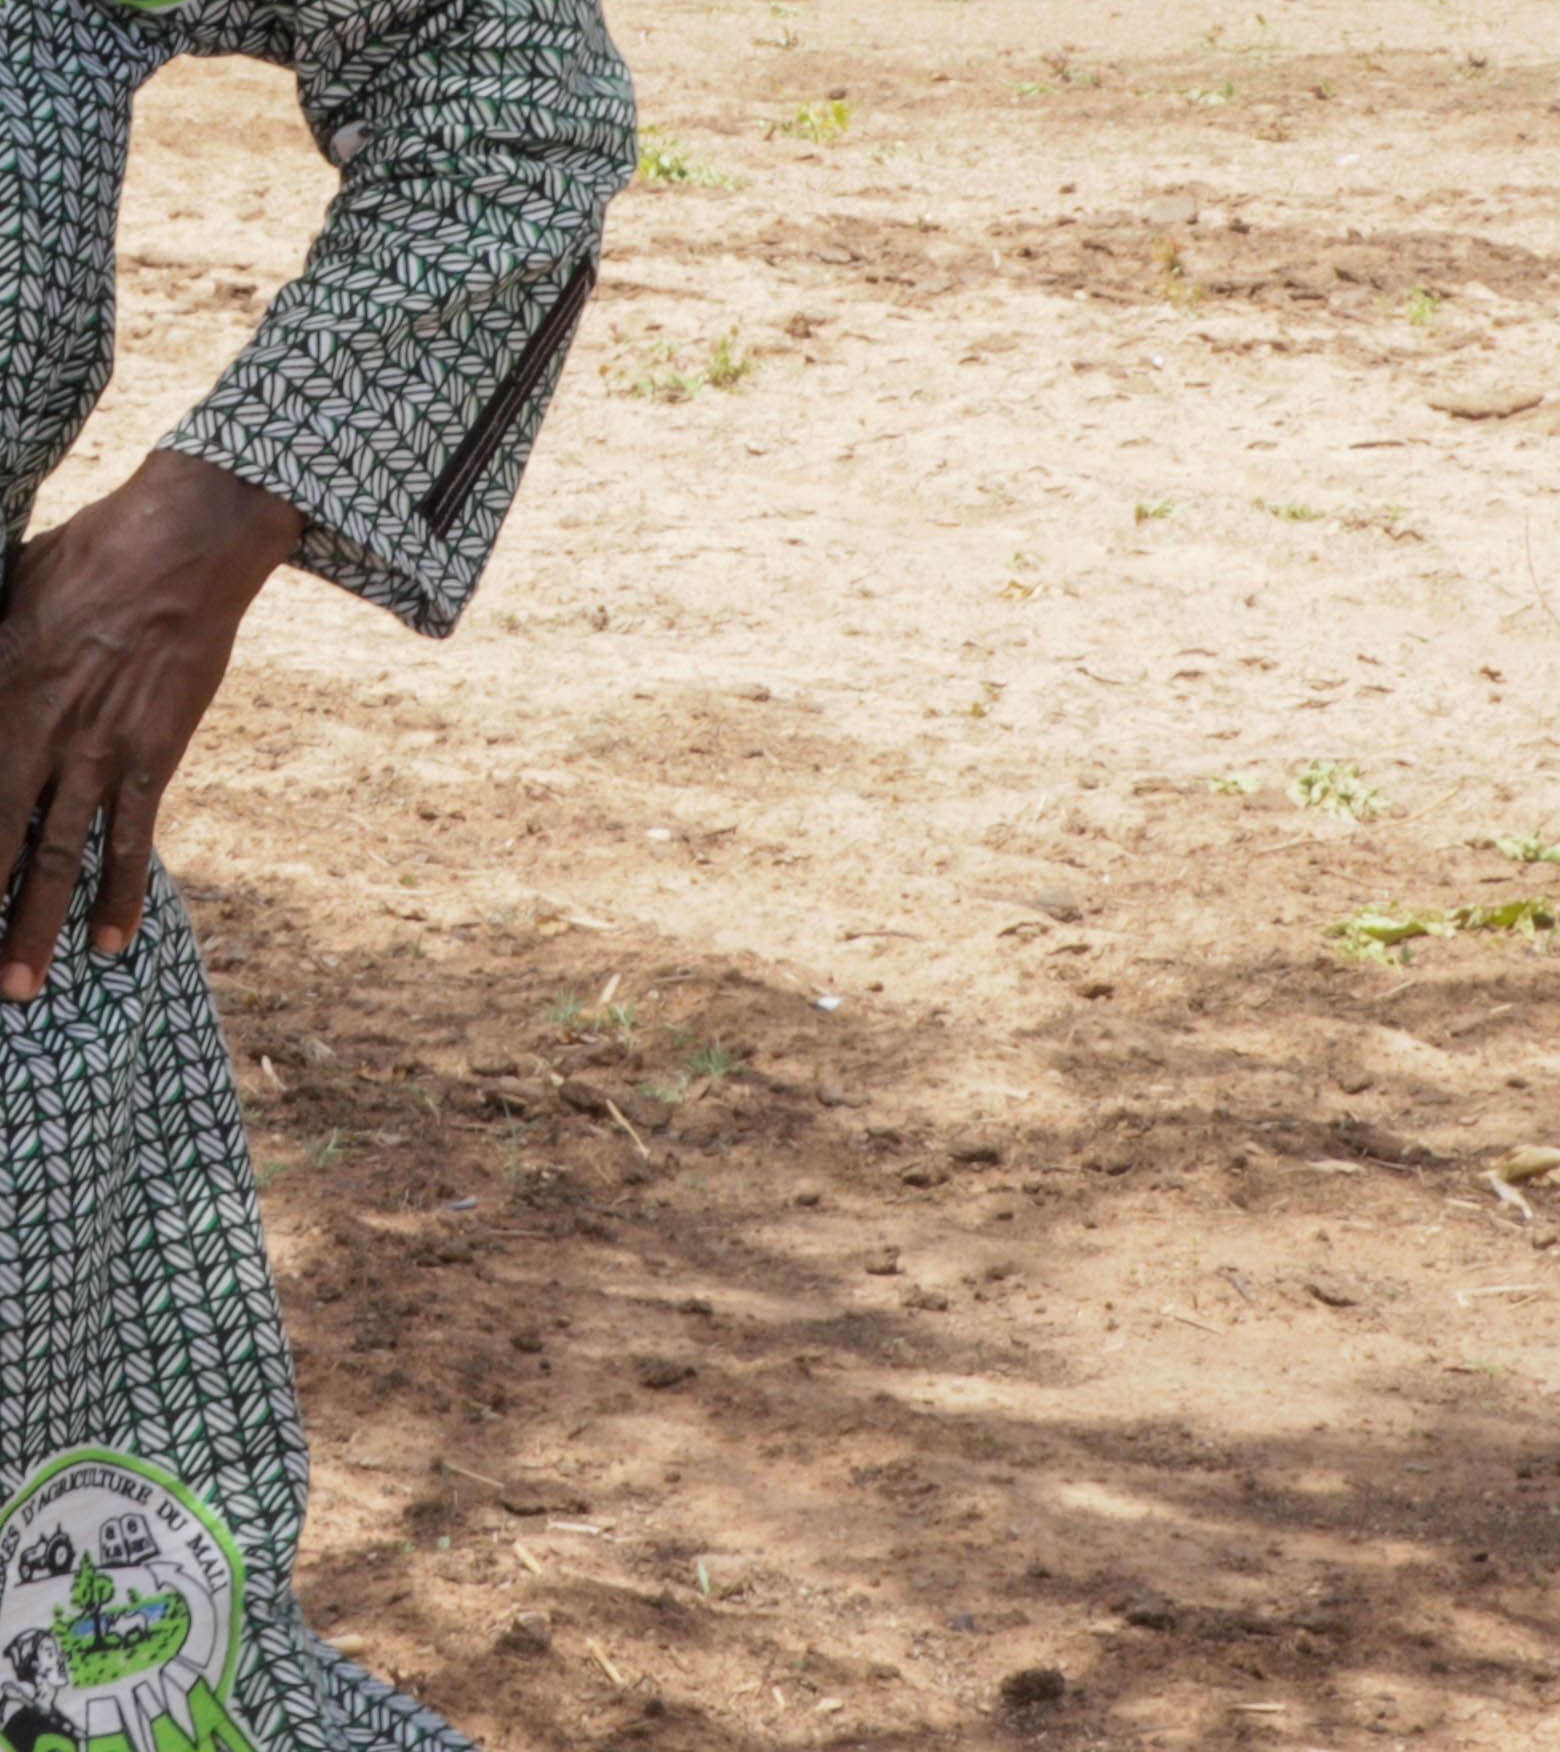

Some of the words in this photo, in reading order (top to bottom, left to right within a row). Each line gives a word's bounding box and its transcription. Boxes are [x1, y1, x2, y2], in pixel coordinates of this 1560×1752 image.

[21, 1466, 155, 1527] D'AGRICULTURE
[156, 1499, 186, 1533] DU
[188, 1533, 229, 1594] MALI
